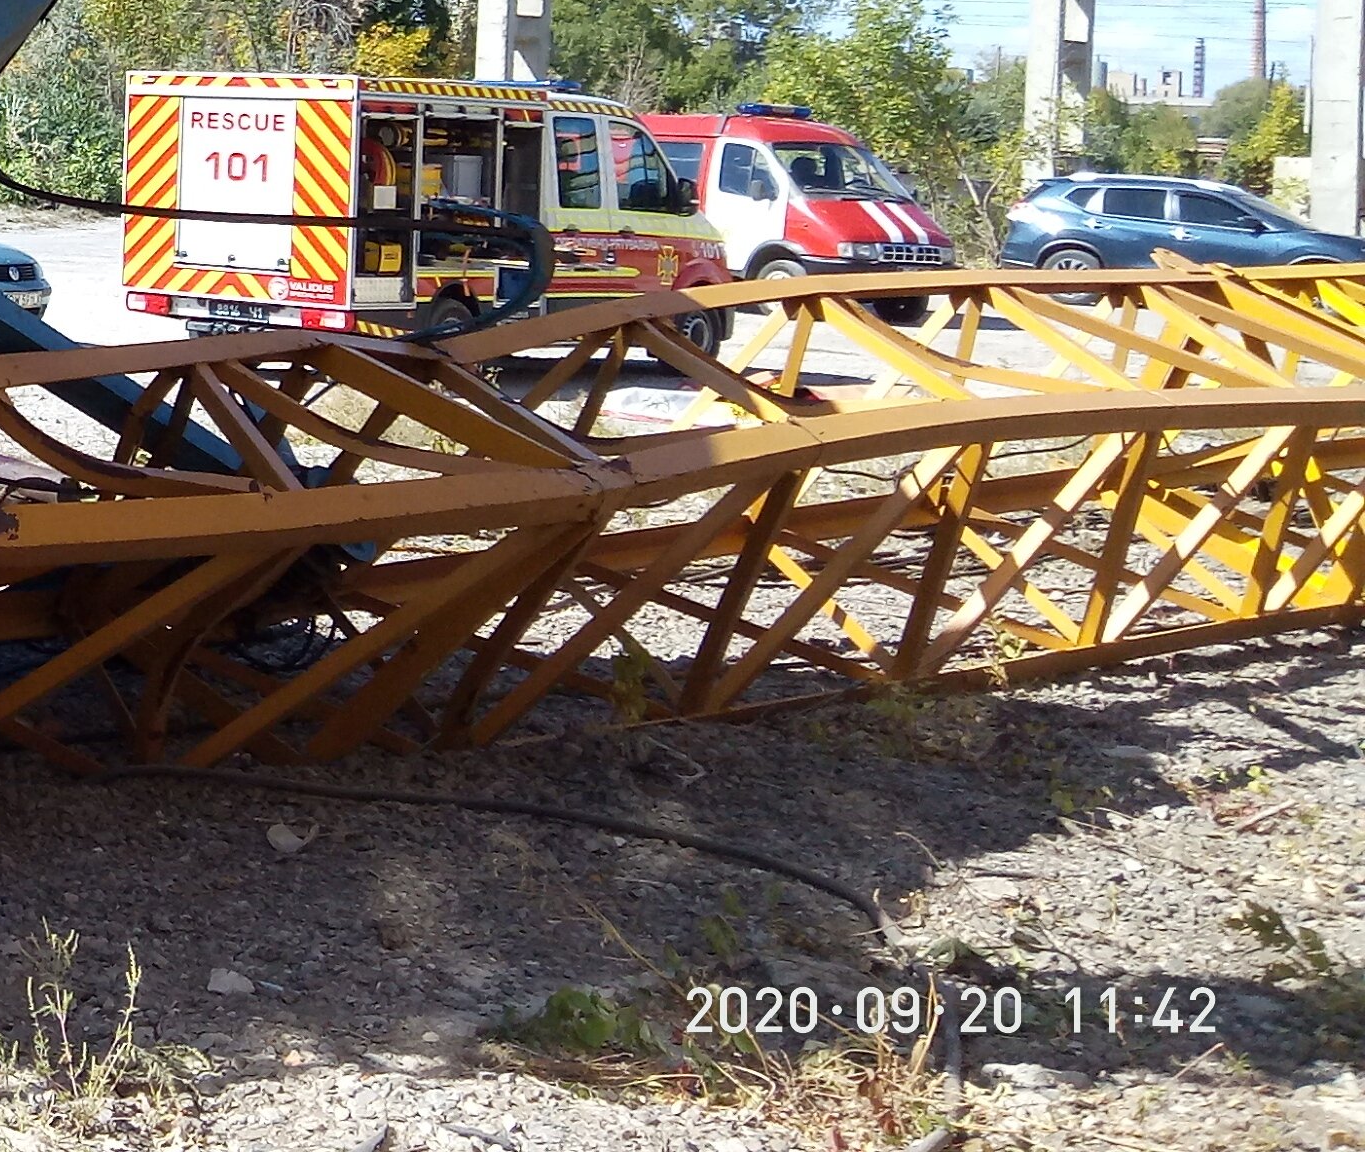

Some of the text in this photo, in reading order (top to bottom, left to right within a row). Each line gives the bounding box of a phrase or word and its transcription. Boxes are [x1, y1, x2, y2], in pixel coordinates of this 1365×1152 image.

[191, 112, 285, 131] RESCUE
[205, 151, 268, 182] 101
[700, 242, 720, 259] 101
[289, 281, 334, 293] VALIDUS
